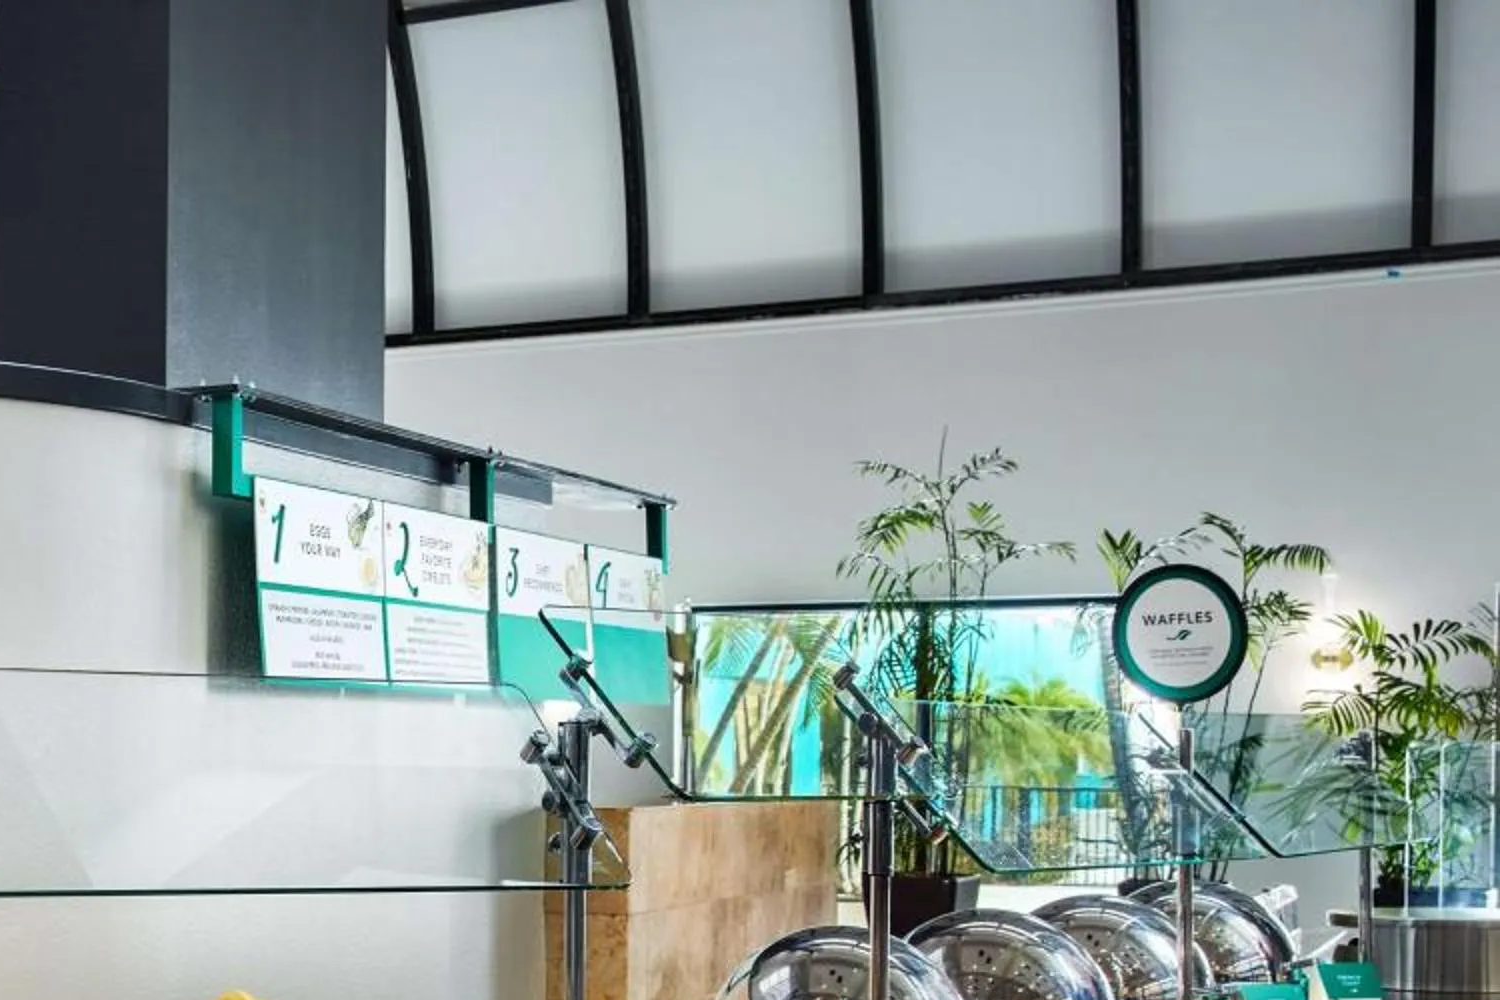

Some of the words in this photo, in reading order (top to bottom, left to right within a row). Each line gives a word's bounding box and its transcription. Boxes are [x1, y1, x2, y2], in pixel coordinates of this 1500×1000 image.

[271, 504, 286, 564] 1
[394, 521, 419, 598] 2
[505, 547, 520, 597] 3
[1142, 611, 1214, 627] WAFFLES
